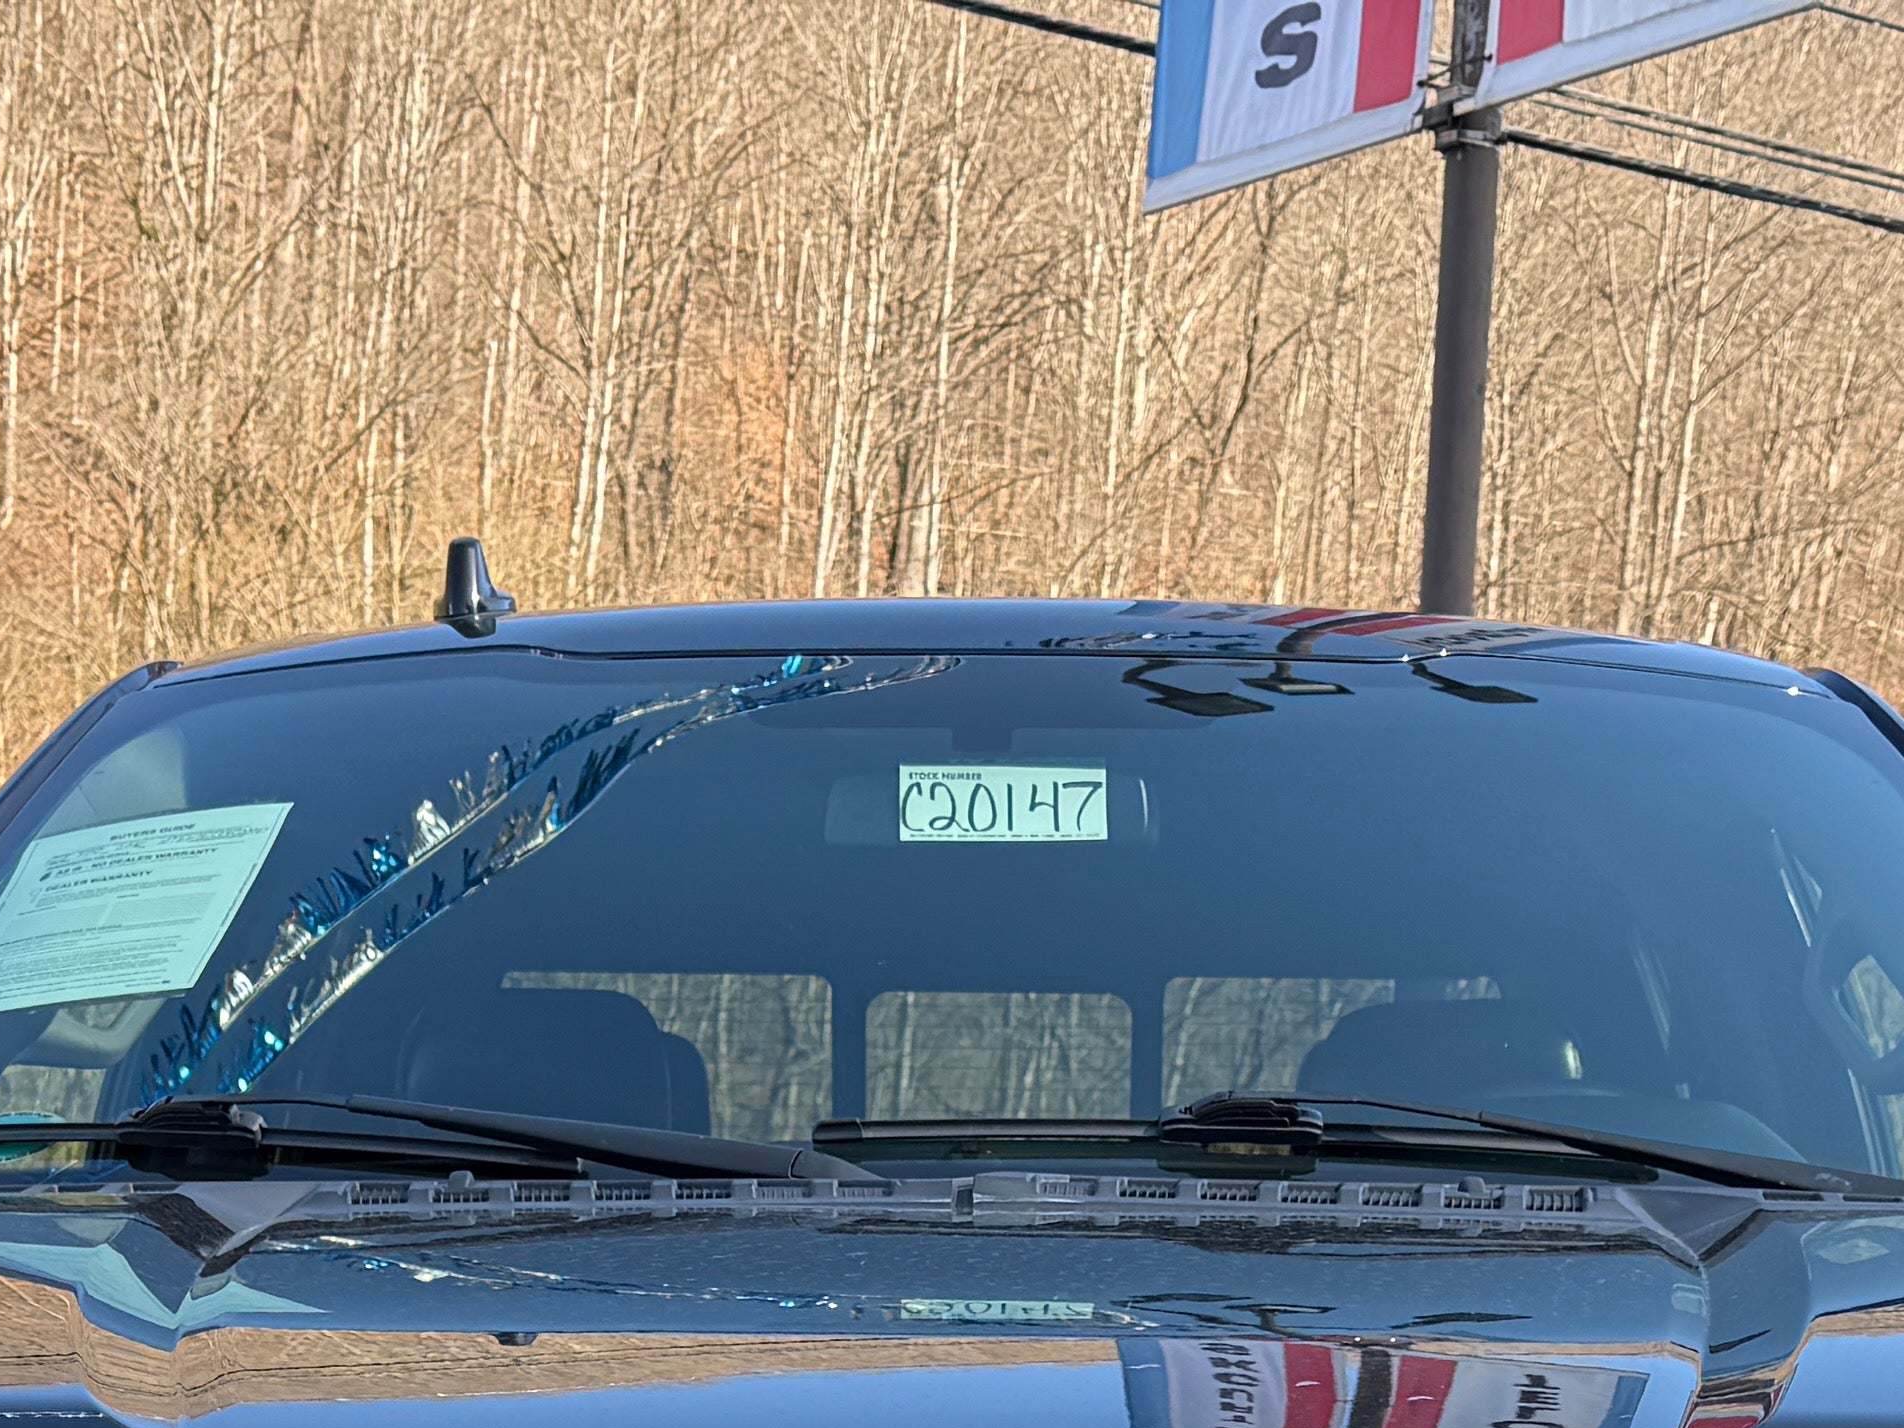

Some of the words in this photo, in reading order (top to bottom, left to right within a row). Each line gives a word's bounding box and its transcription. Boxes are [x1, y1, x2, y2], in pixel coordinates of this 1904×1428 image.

[908, 771, 940, 780] STOCK
[941, 772, 982, 781] NUMBER
[900, 780, 1103, 833] C20147
